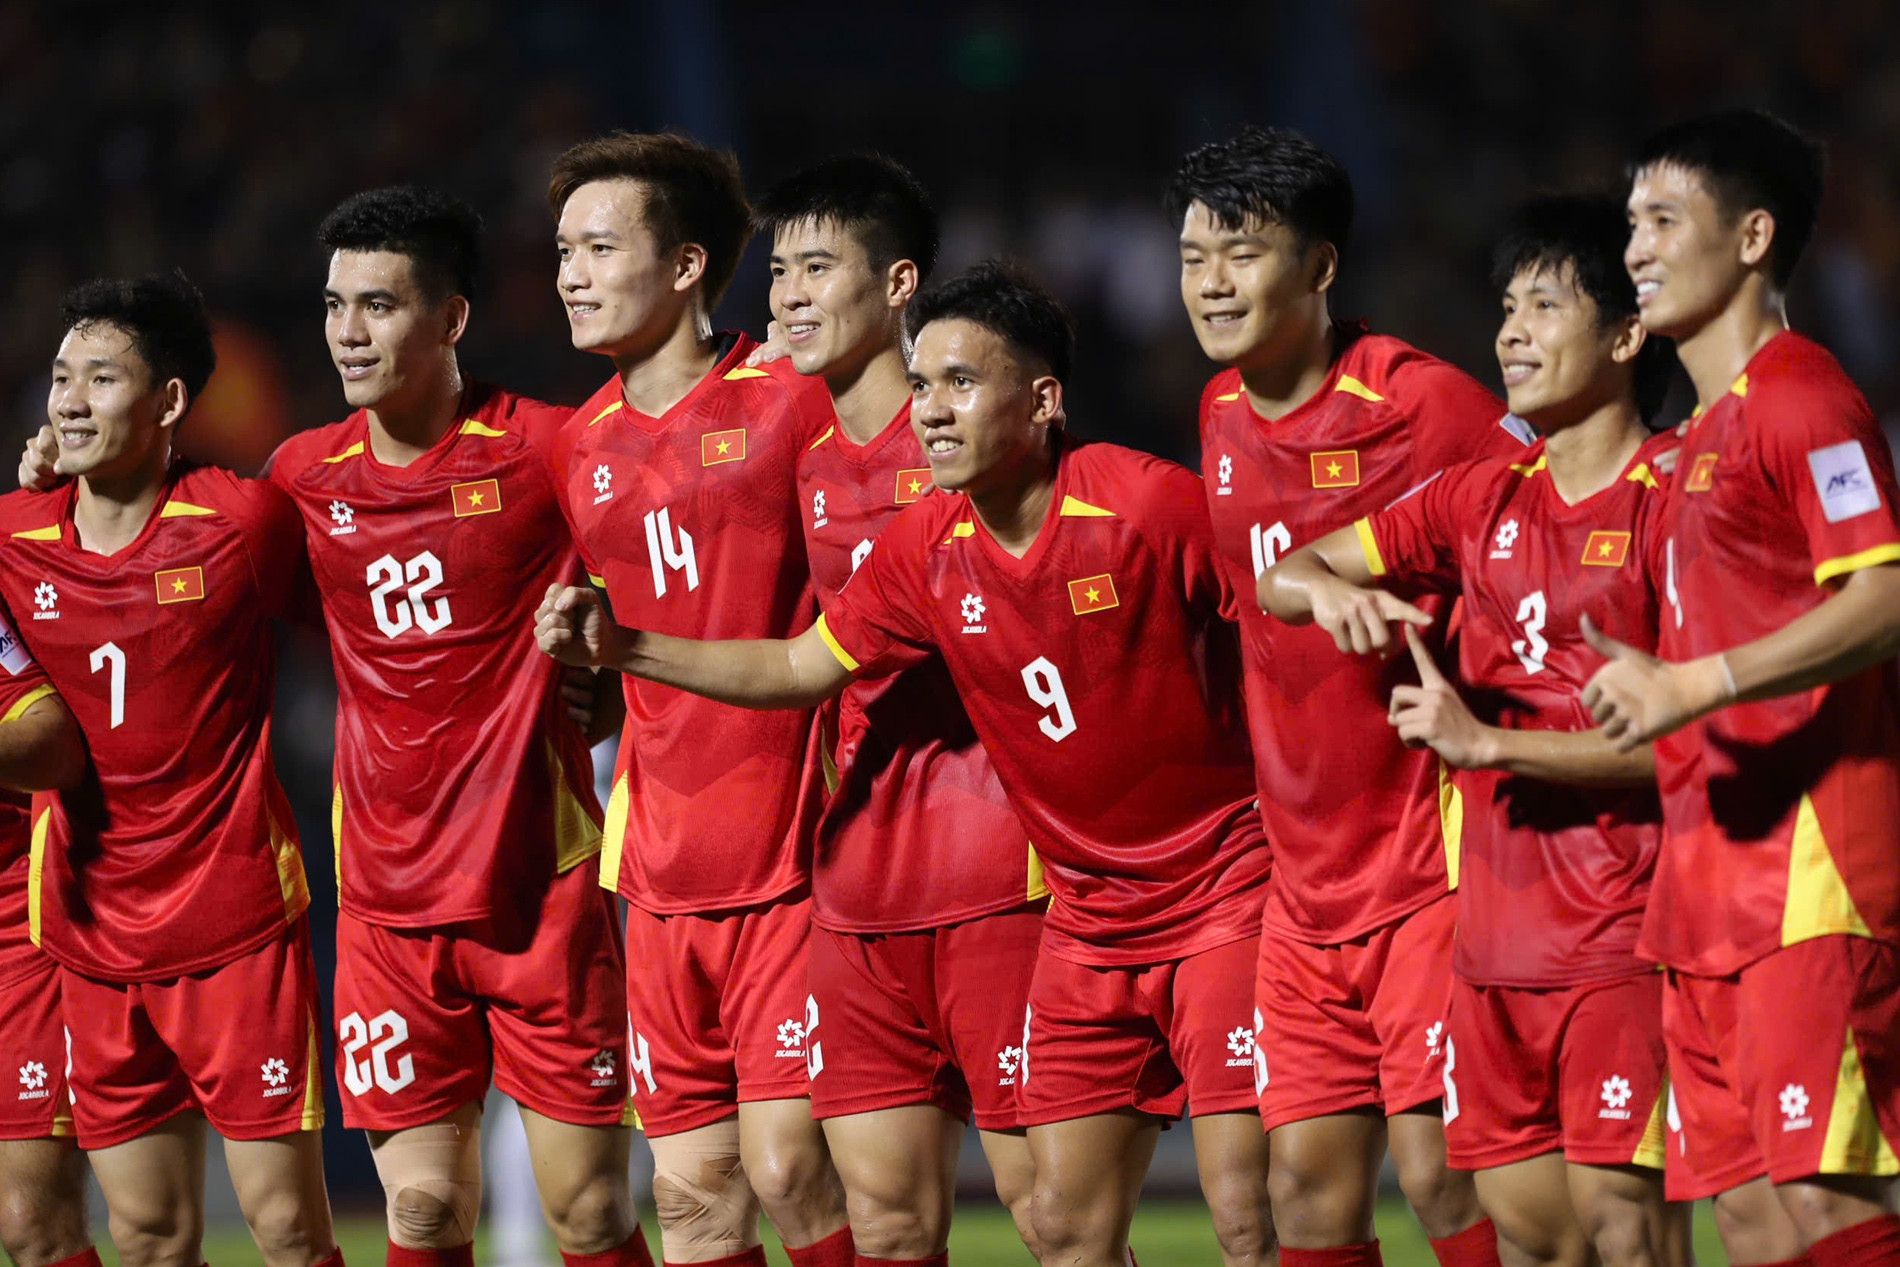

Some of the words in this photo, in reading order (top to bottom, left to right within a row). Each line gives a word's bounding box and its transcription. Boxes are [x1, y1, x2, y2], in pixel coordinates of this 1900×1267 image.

[366, 551, 453, 639] 22
[643, 507, 700, 599] 14
[1512, 591, 1548, 674] 3
[89, 642, 126, 729] 7
[1021, 656, 1077, 743] 9
[340, 1009, 416, 1096] 22
[1225, 1058, 1254, 1067] JOGARBOL
